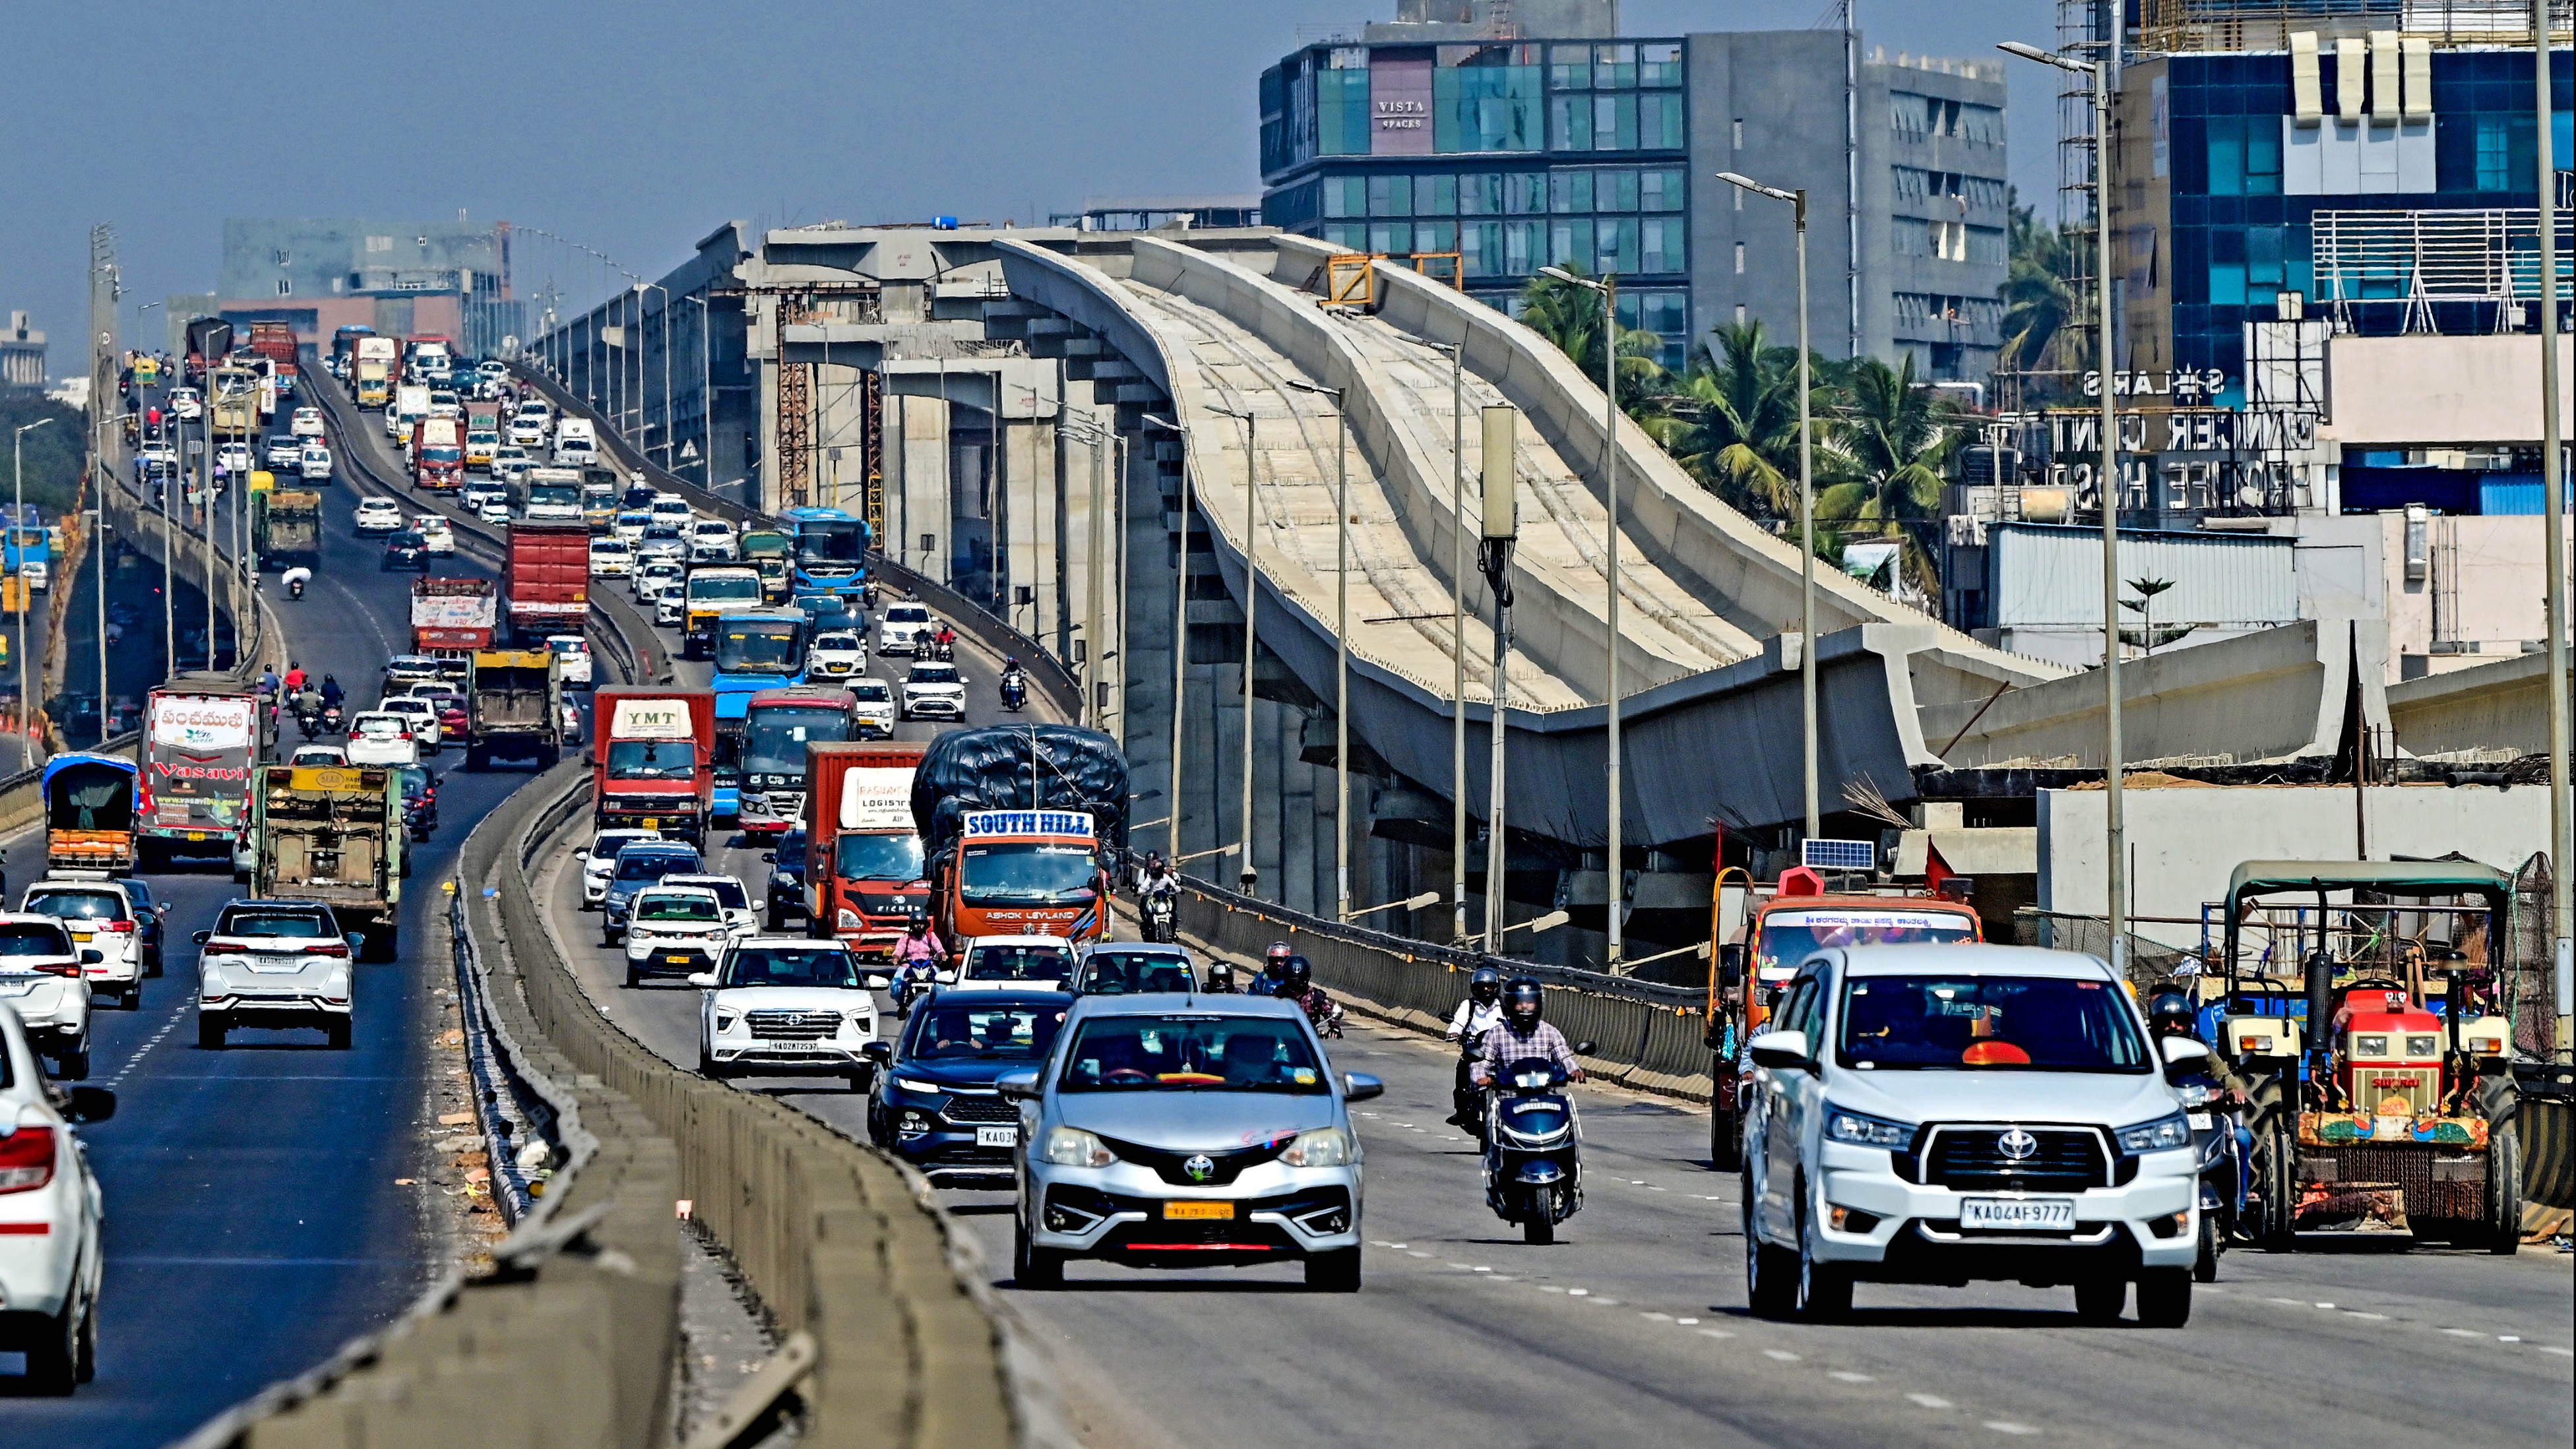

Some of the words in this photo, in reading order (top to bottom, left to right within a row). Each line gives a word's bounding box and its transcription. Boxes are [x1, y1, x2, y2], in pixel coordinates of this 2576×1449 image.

[1379, 101, 1424, 113] VISTA
[1383, 119, 1421, 128] SPACES
[629, 712, 675, 724] YMT
[154, 761, 244, 780] Vasavi
[968, 813, 1036, 834] SOUTH
[1040, 813, 1090, 835] HILL
[1974, 1205, 2071, 1221] KA04AF9777
